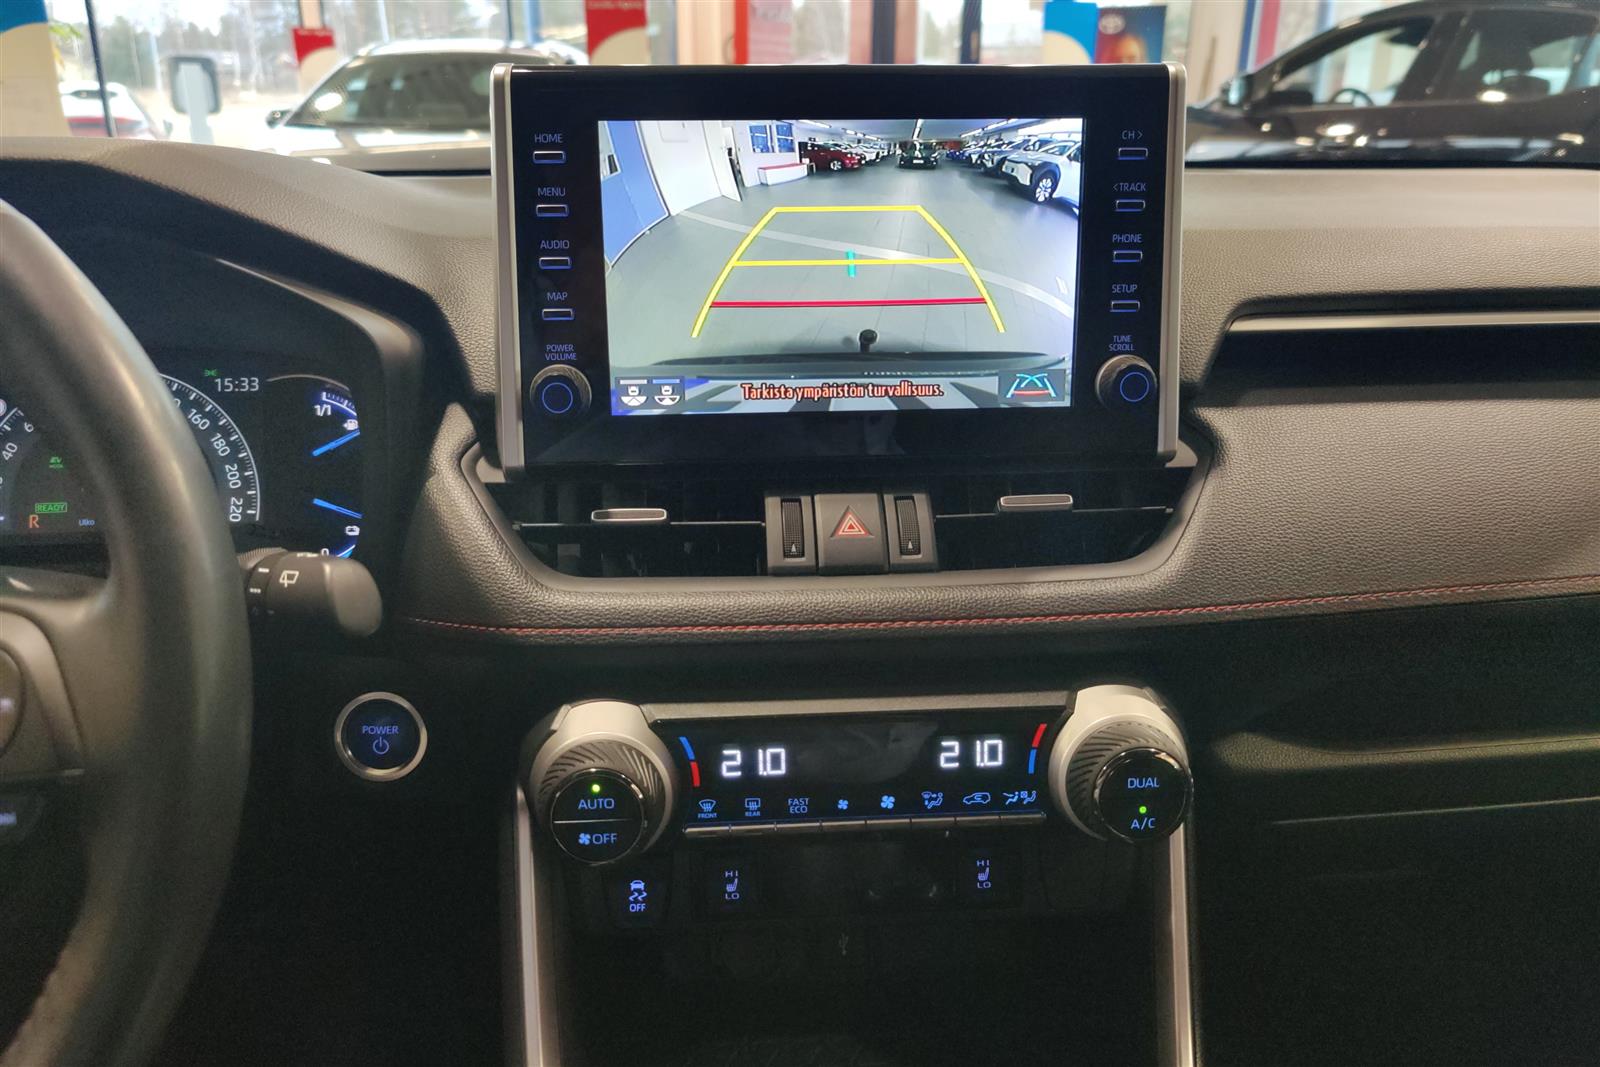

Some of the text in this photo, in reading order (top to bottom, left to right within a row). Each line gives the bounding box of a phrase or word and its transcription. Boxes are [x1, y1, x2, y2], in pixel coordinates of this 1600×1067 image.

[534, 133, 563, 144] HOME
[537, 186, 566, 197] MENU
[1112, 233, 1142, 244] PHONE
[540, 239, 570, 250] AUDIO
[1111, 283, 1138, 294] SETUP
[546, 291, 568, 302] MAP
[1112, 335, 1132, 343] TUNE
[546, 344, 574, 352] POWER
[1108, 343, 1135, 351] SCROLL
[544, 352, 577, 361] VOLUME
[215, 377, 260, 392] 15:33
[741, 384, 796, 400] Tarkista
[866, 380, 944, 397] turvallisuus.
[187, 408, 210, 430] 160
[210, 433, 230, 457] 180
[2, 442, 19, 461] 40
[225, 463, 241, 489] 200
[37, 503, 65, 513] READY
[229, 496, 243, 522] 220
[29, 514, 40, 529] R
[362, 725, 400, 735] POWER
[1126, 776, 1160, 790] DUAL
[577, 797, 615, 811] AUTO
[787, 797, 810, 807] FAST
[788, 805, 808, 814] ECO
[1130, 817, 1156, 831] A/C
[591, 832, 618, 846] OFF
[724, 892, 740, 901] LO
[629, 903, 646, 913] OFF
